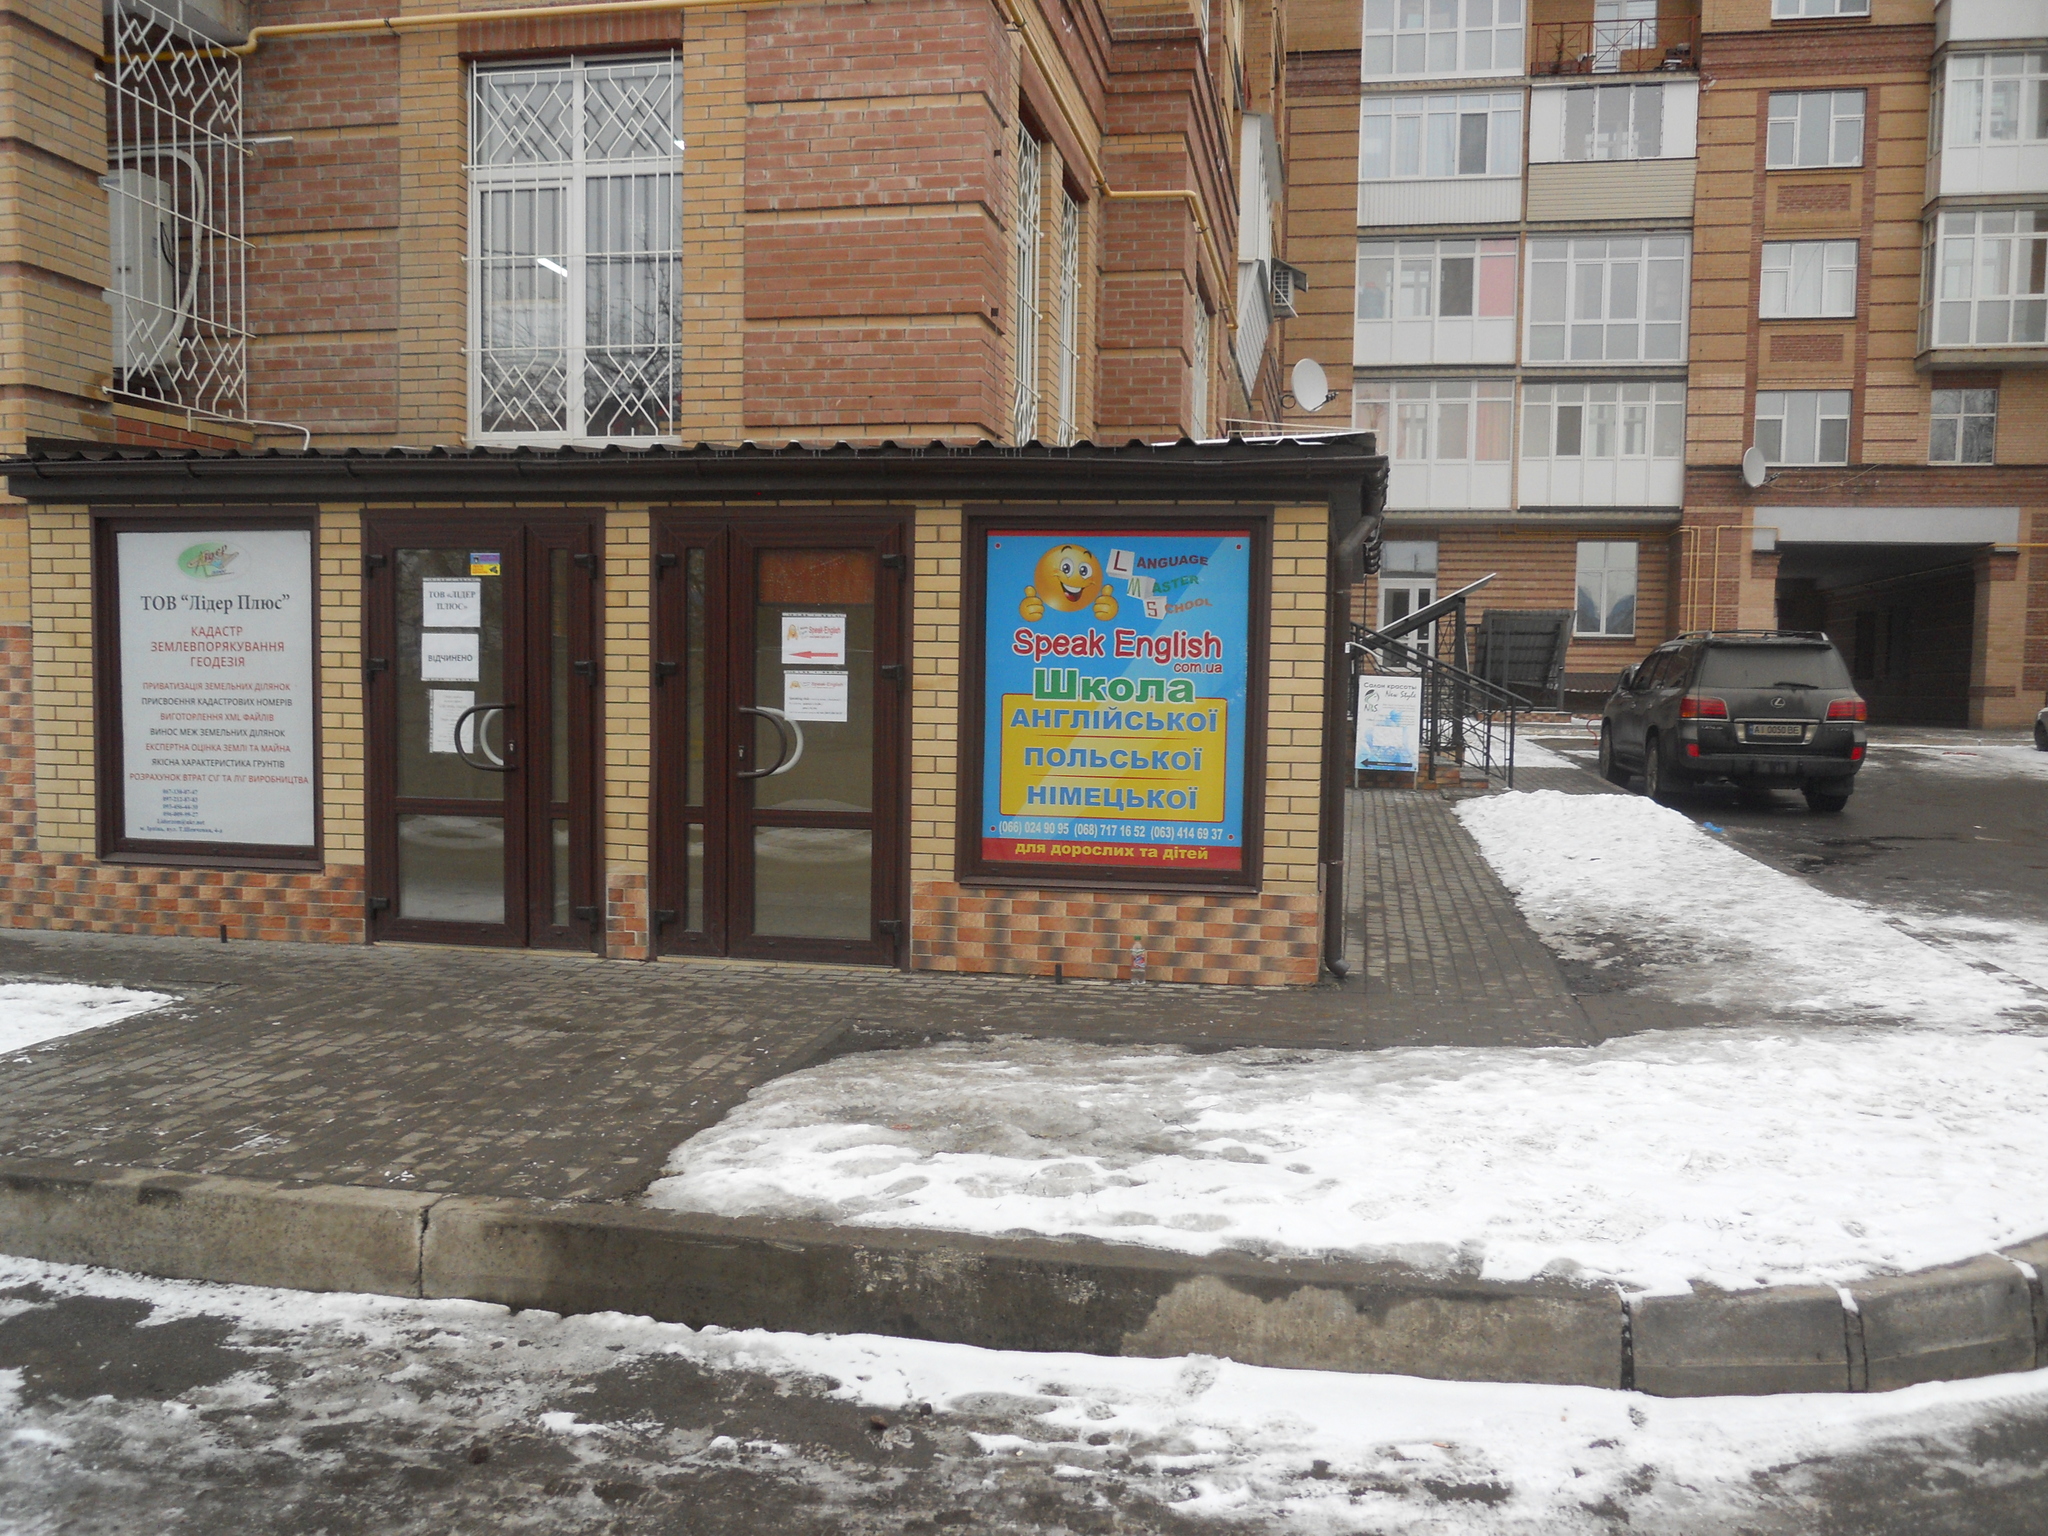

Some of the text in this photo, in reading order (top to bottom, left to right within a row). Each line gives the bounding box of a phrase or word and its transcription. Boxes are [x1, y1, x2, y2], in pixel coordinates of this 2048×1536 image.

[428, 591, 446, 599] ТОВ
[141, 595, 177, 611] ТОВ
[191, 626, 243, 638] КАДАСТР
[151, 641, 285, 652] ЗЕМЛЕВПОРЯКУВАННЯ
[1012, 628, 1222, 664] Speak English
[190, 656, 245, 668] ГЕОДЕЗІЯ
[427, 654, 473, 663] ВІДЧИНЕНО
[1173, 662, 1223, 674] com.ua
[142, 682, 291, 692] ПРИВАТИЗАЦІЯ ЗЕМЕЛЬНИХ ДІЛЯНОК
[1033, 668, 1195, 703] Школа
[1385, 690, 1417, 700] New Style
[141, 697, 293, 707] ПРИСВОЄННЯ КАДАСТРОВИХ НОМЕРІВ
[243, 711, 275, 722] ФАЙЛІВ
[1010, 706, 1219, 733] АНГЛІЙСЬКОЇ
[150, 728, 286, 738] ВИНОС МЕЖ ЗЕМЕЛЬНИХ ДІЛЯНОК
[1787, 726, 1800, 735] BE
[145, 743, 291, 753] ЕКСПЕРТНА ОЦІНКА ЗЕМЛІ ТА МАЙНА
[151, 758, 180, 766] ЯКІСНА
[181, 759, 251, 768] ХАРАКТЕРИСТИКА
[1024, 746, 1203, 772] ПОЛЬСЬКОЇ
[129, 773, 181, 781] РОЗРАХУНОК
[249, 775, 309, 784] ВИРОБНИЦТВА
[1026, 785, 1198, 811] НІМЕЦЬКОЇ
[999, 821, 1223, 841] (066) 024 90 95 (068) 717 16 52 (063) 414 69 37
[1015, 843, 1208, 860] для дорослих та дітей
